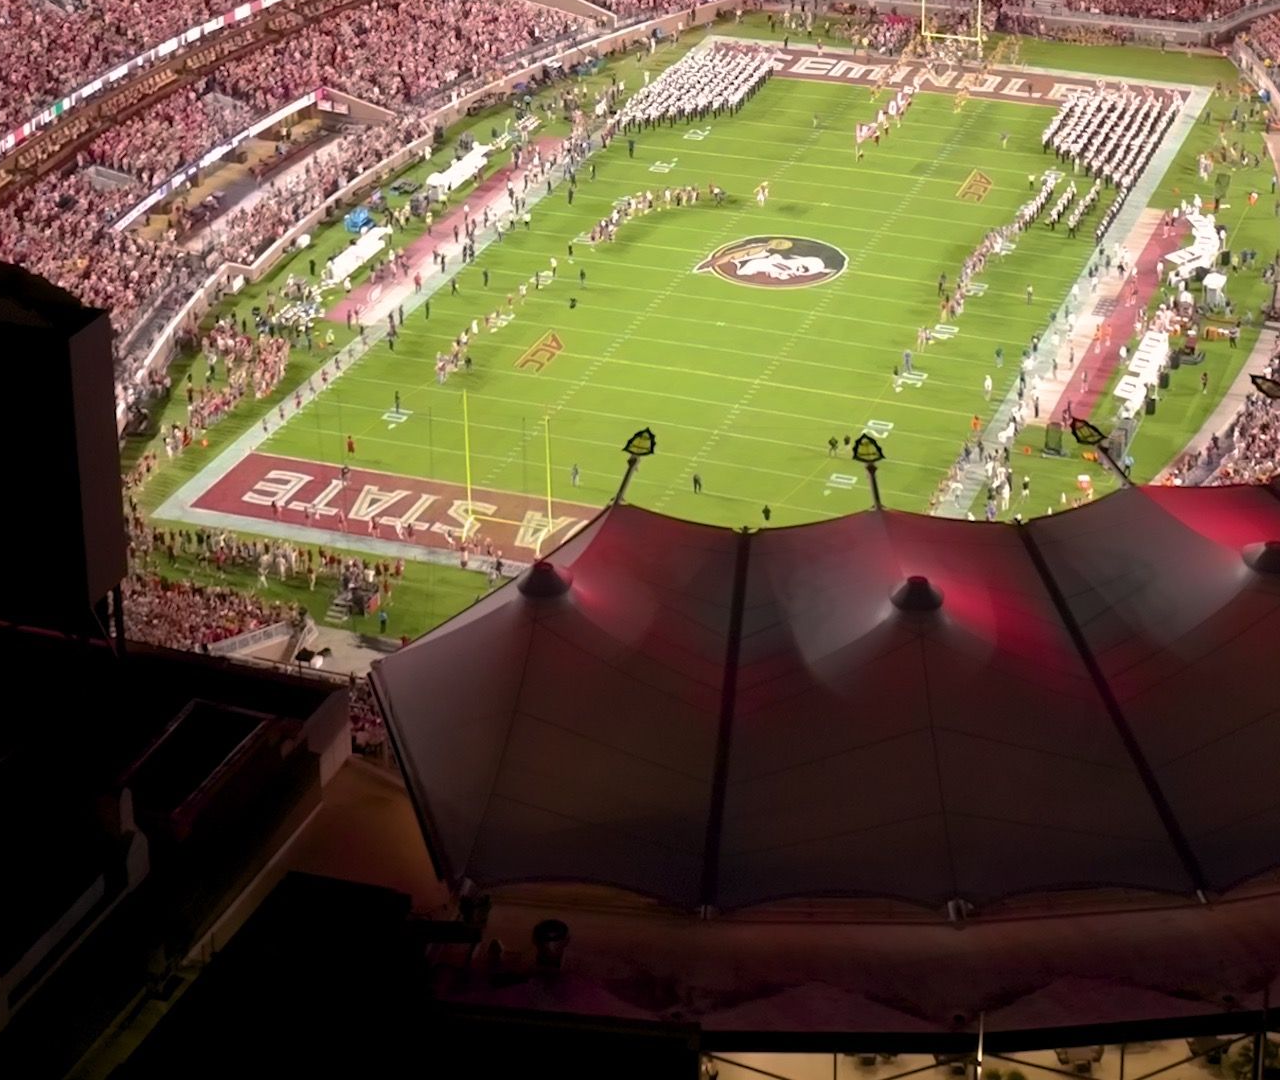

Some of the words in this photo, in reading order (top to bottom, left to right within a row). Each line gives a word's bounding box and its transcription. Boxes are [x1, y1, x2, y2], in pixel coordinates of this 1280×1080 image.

[961, 172, 992, 203] ACC
[521, 333, 564, 372] ACC
[241, 470, 499, 537] STATE
